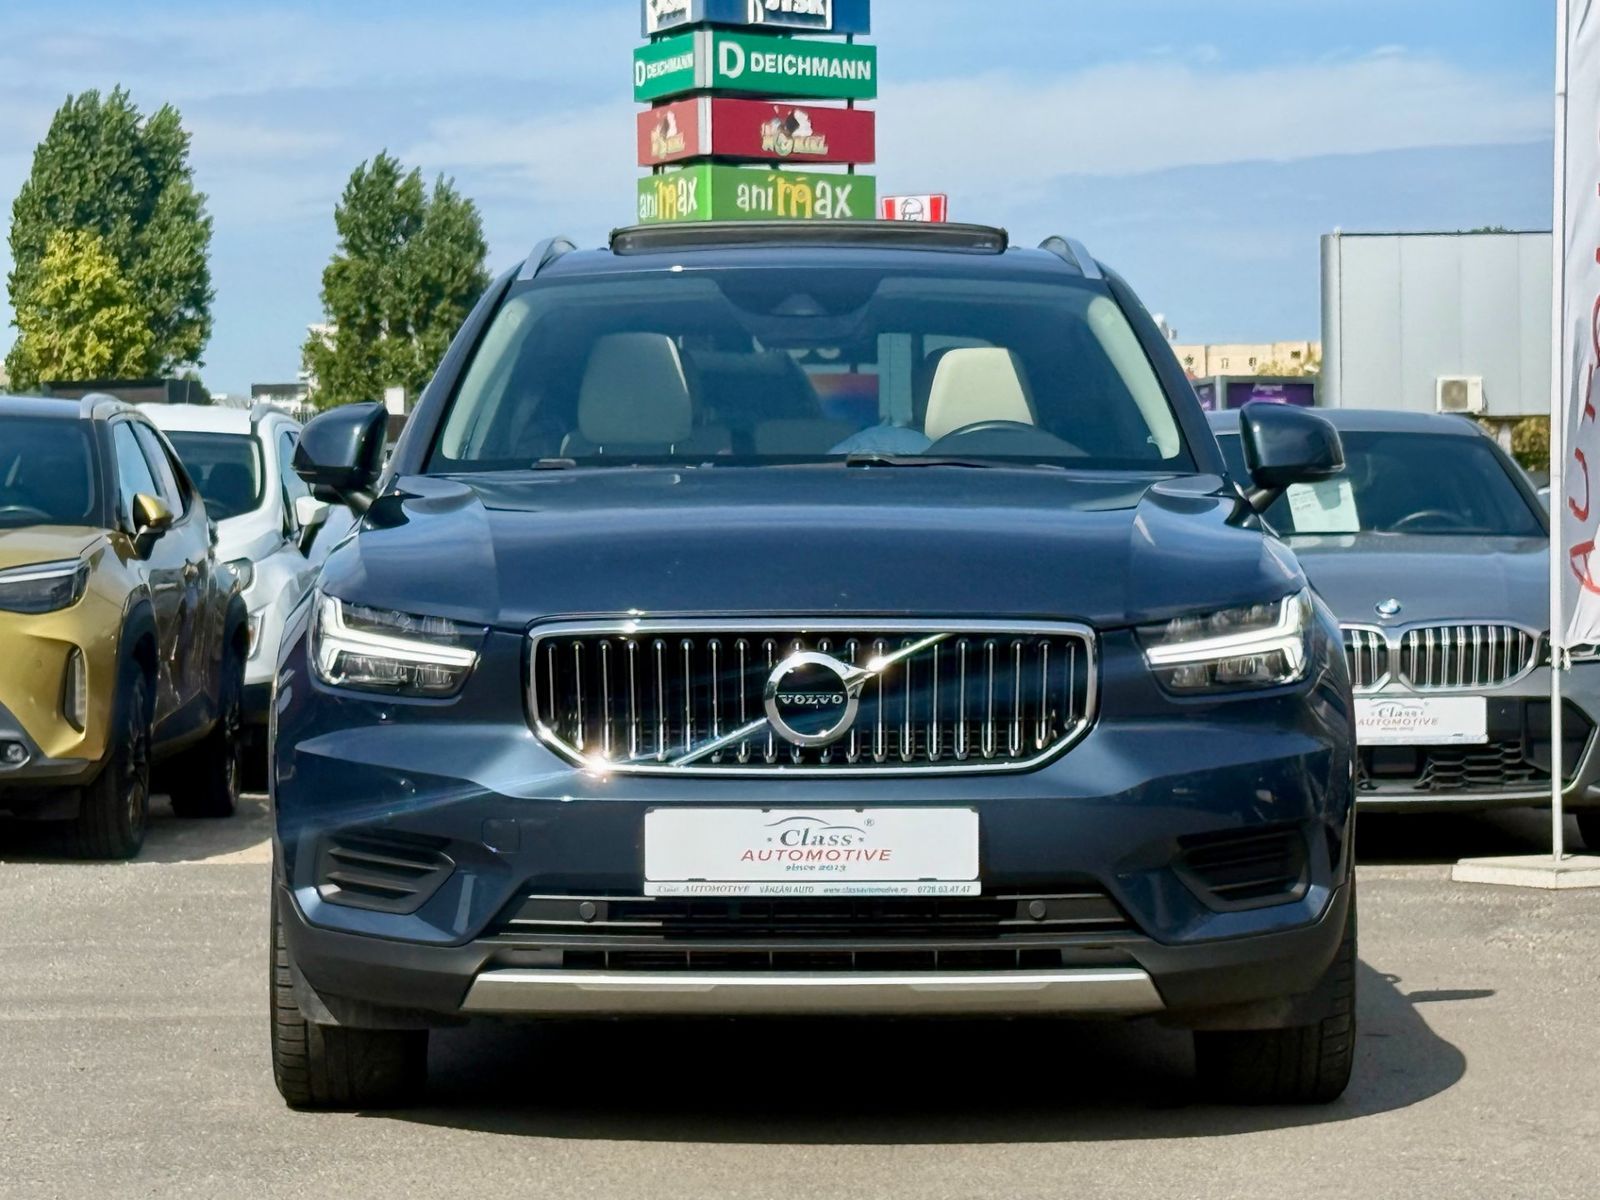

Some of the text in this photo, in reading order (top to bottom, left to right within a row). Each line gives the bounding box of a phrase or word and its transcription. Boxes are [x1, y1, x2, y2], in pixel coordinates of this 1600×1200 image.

[750, 51, 871, 80] DEICHMANN
[639, 176, 698, 219] animax
[736, 174, 853, 219] animax
[778, 694, 844, 705] VOLVO
[779, 827, 853, 847] Class
[740, 849, 893, 862] AUTOMOTIVE
